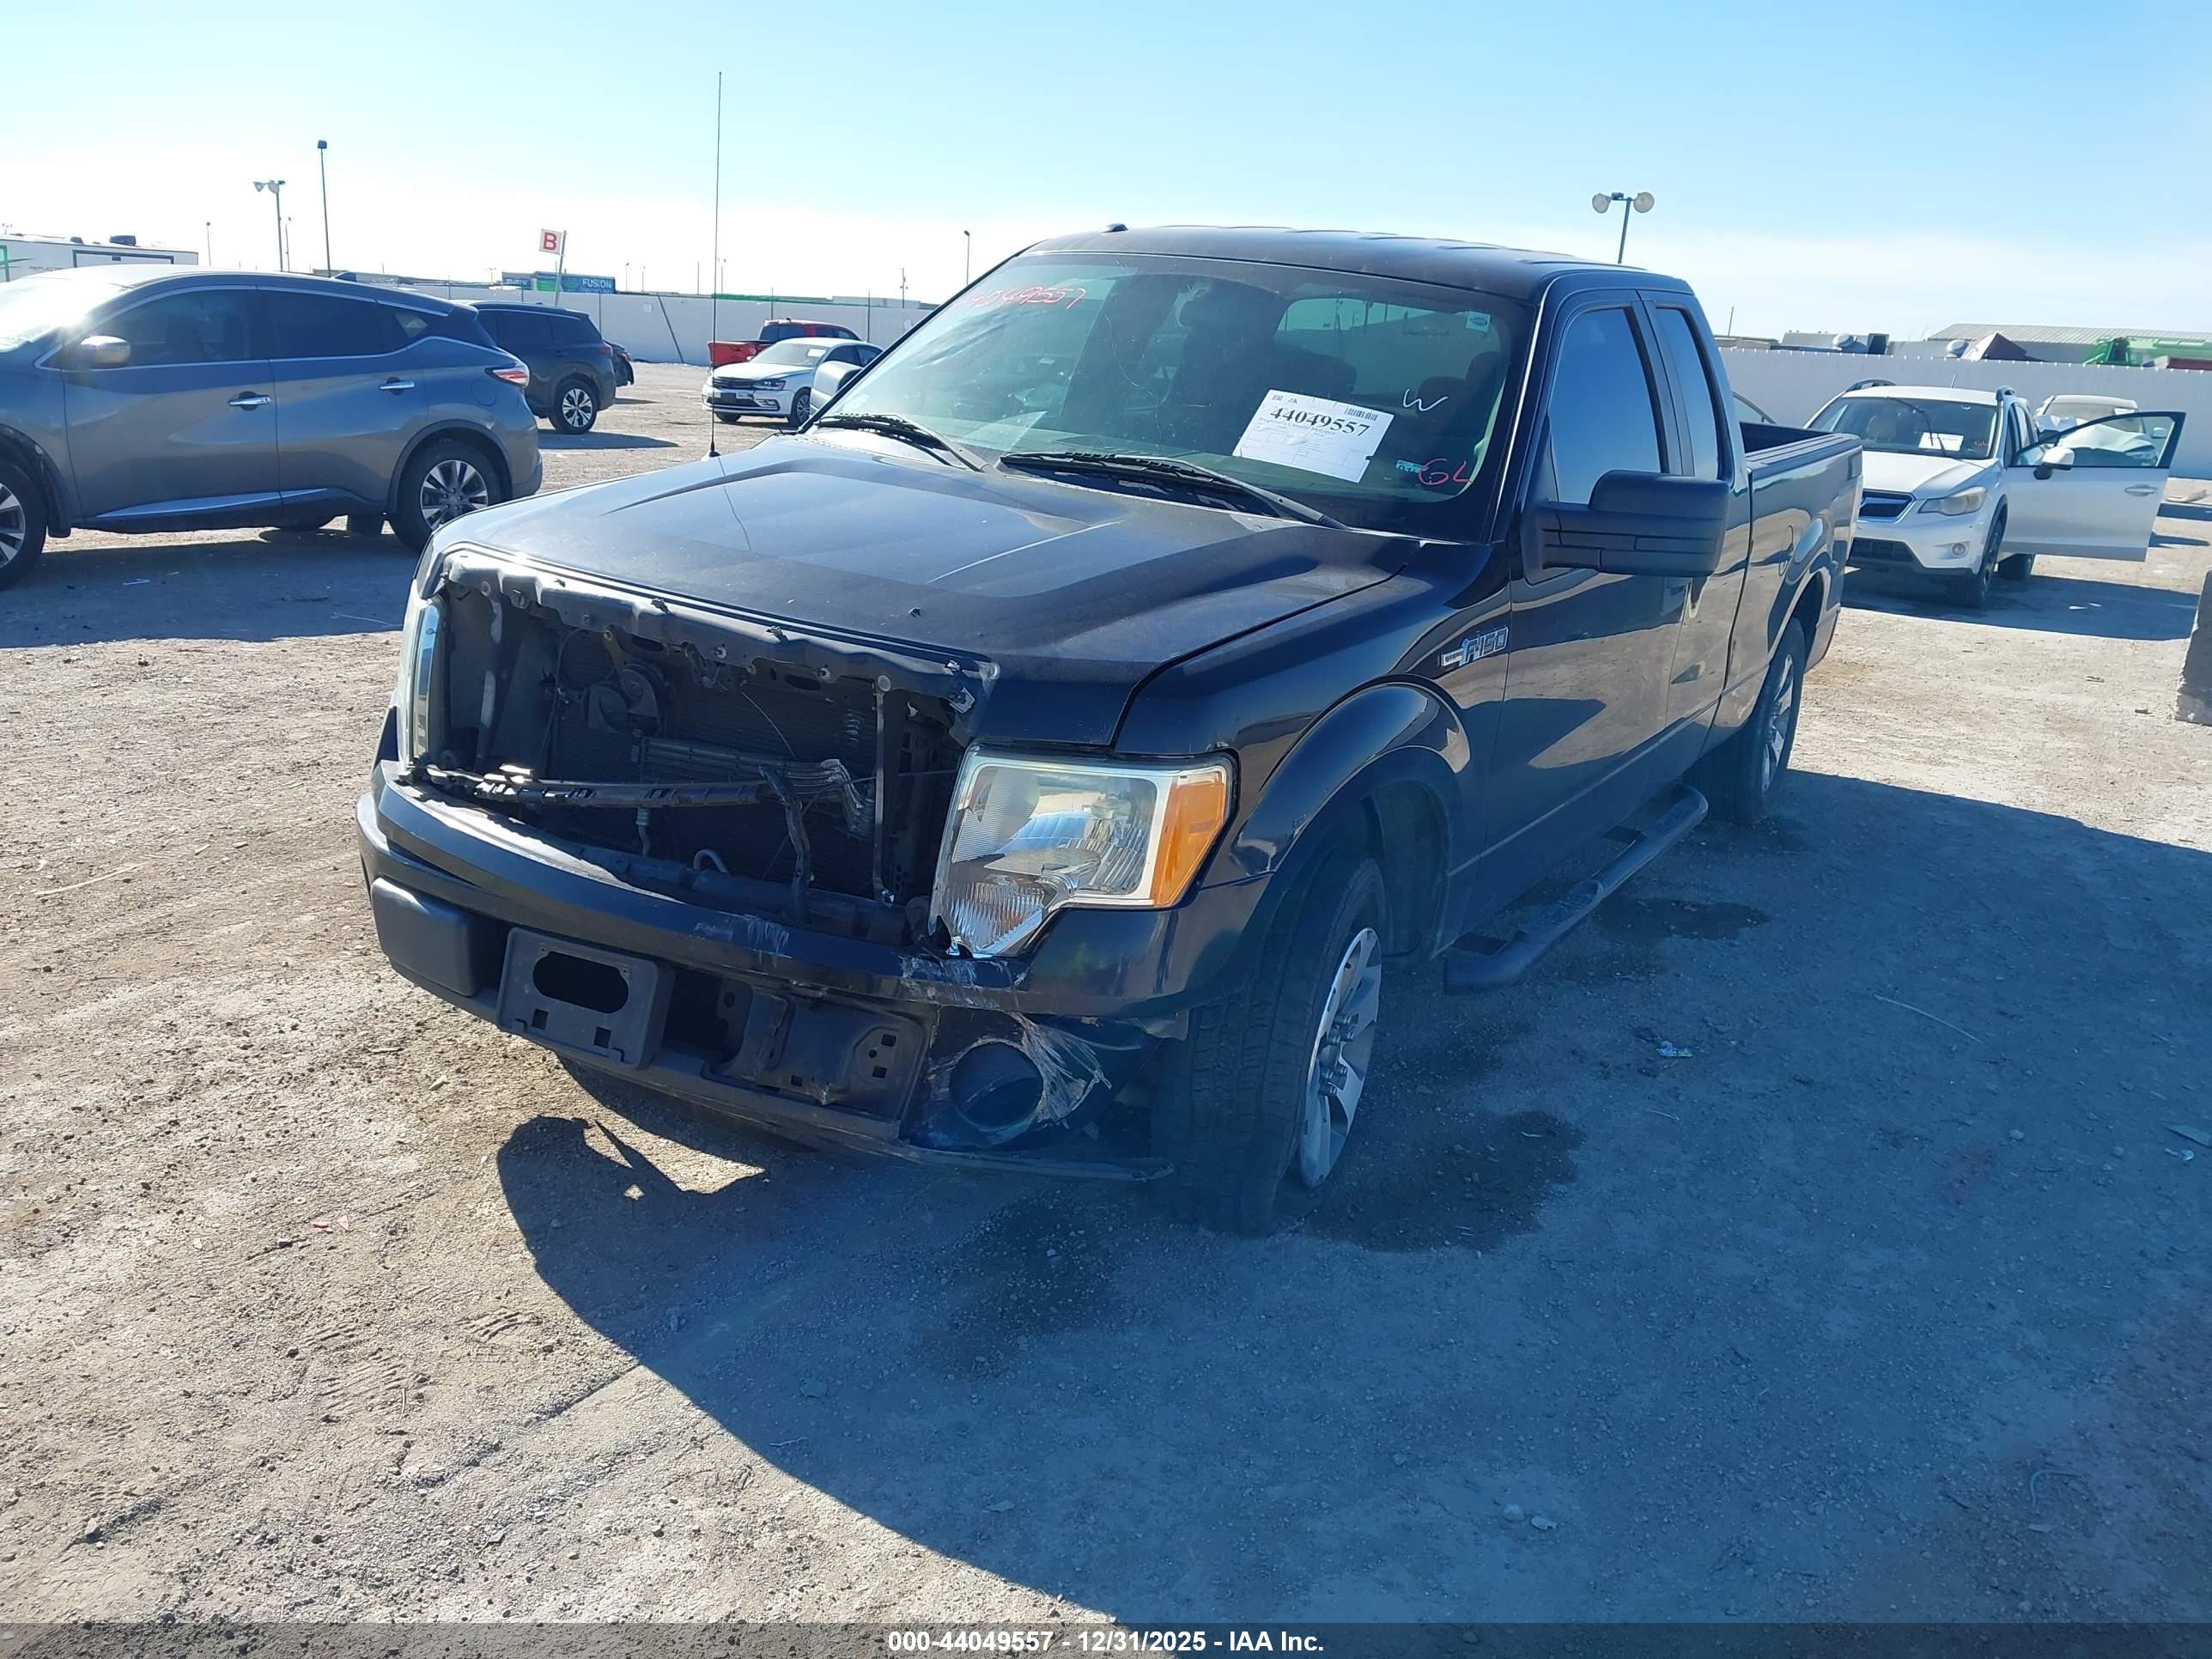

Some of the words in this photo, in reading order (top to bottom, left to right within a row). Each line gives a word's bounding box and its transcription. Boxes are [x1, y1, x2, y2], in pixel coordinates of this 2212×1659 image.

[542, 231, 557, 251] B
[581, 277, 612, 289] FUSION
[1270, 407, 1371, 437] 44049557
